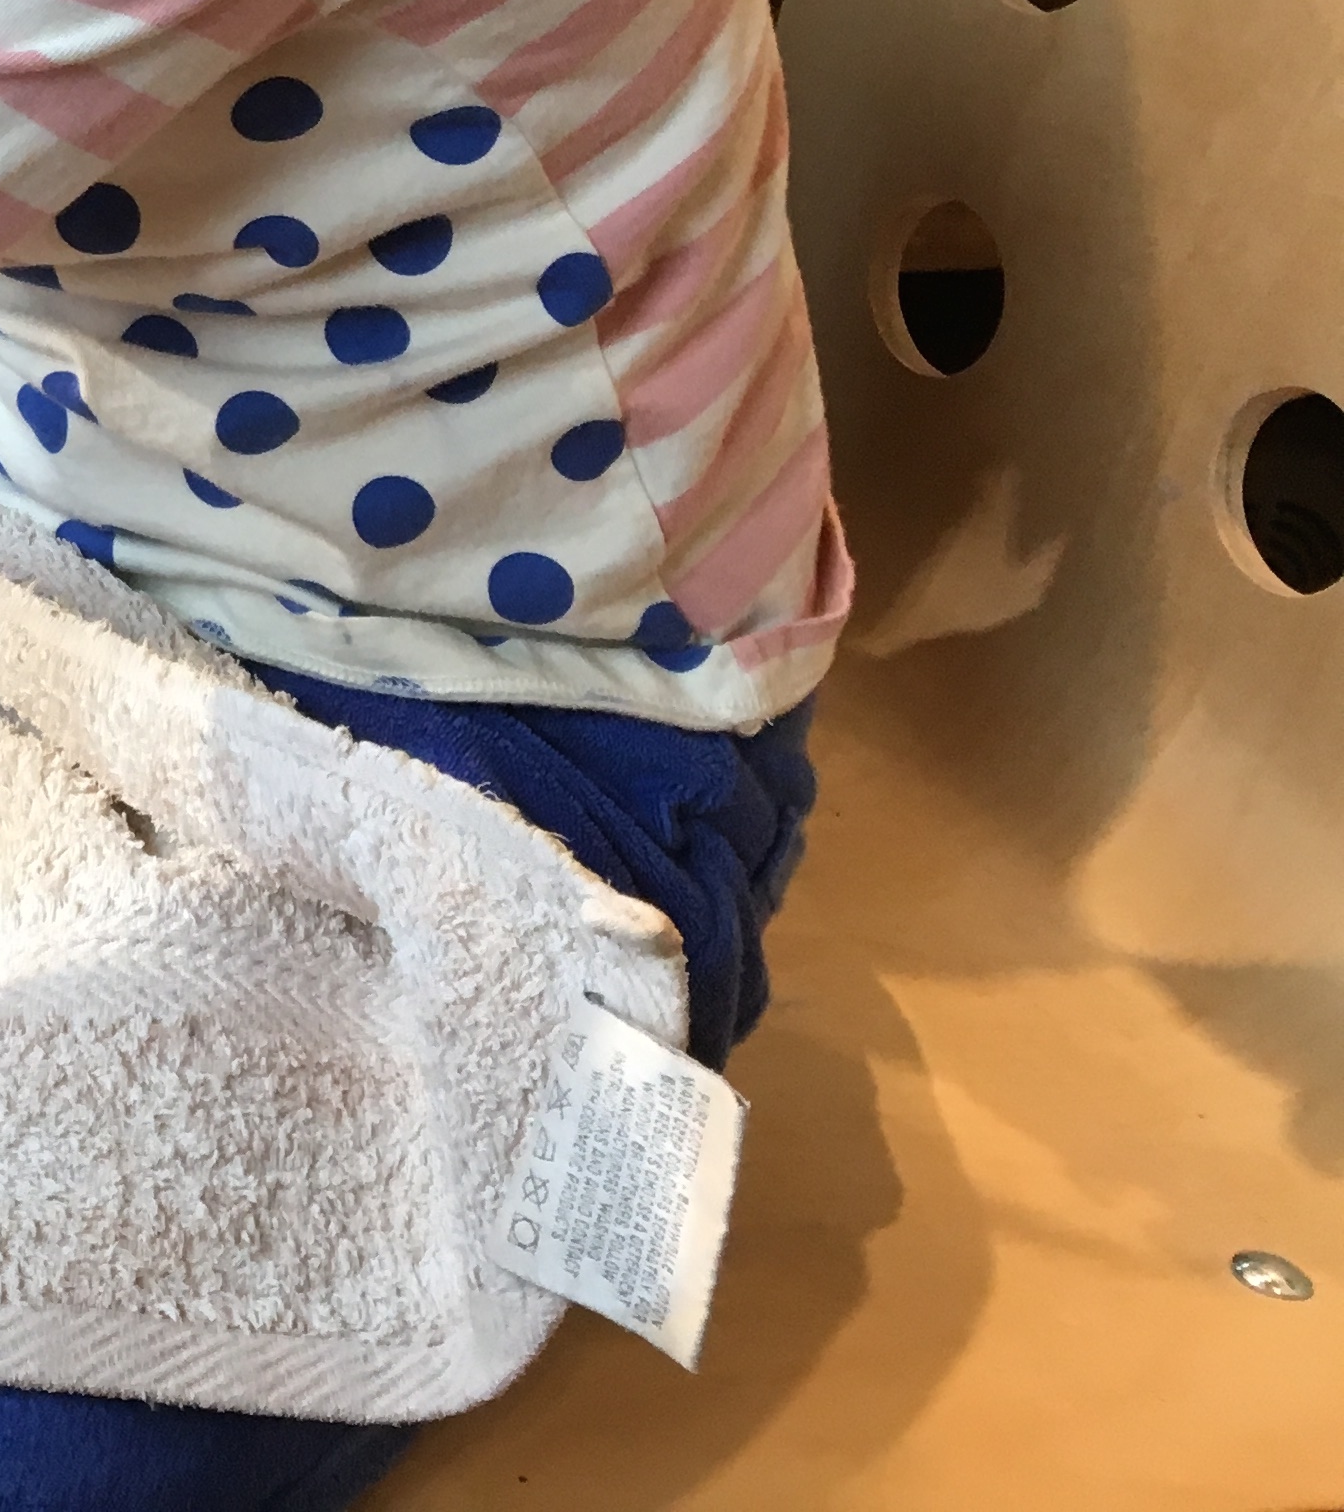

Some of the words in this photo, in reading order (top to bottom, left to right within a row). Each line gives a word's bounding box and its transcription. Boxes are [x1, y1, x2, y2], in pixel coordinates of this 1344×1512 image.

[584, 1145, 607, 1179] AND
[655, 1150, 683, 1214] COLOURS
[679, 1127, 704, 1182] COTTON
[549, 1169, 581, 1244] PRODUCTS
[575, 1174, 601, 1220] AVOID
[634, 1167, 661, 1223] CHOOSE
[560, 1215, 591, 1280] CONTACT
[585, 1198, 615, 1264] WASHING
[599, 1229, 627, 1286] FOLLOW
[637, 1212, 670, 1296] SEPARATELY
[614, 1232, 646, 1309] DETERGENT
